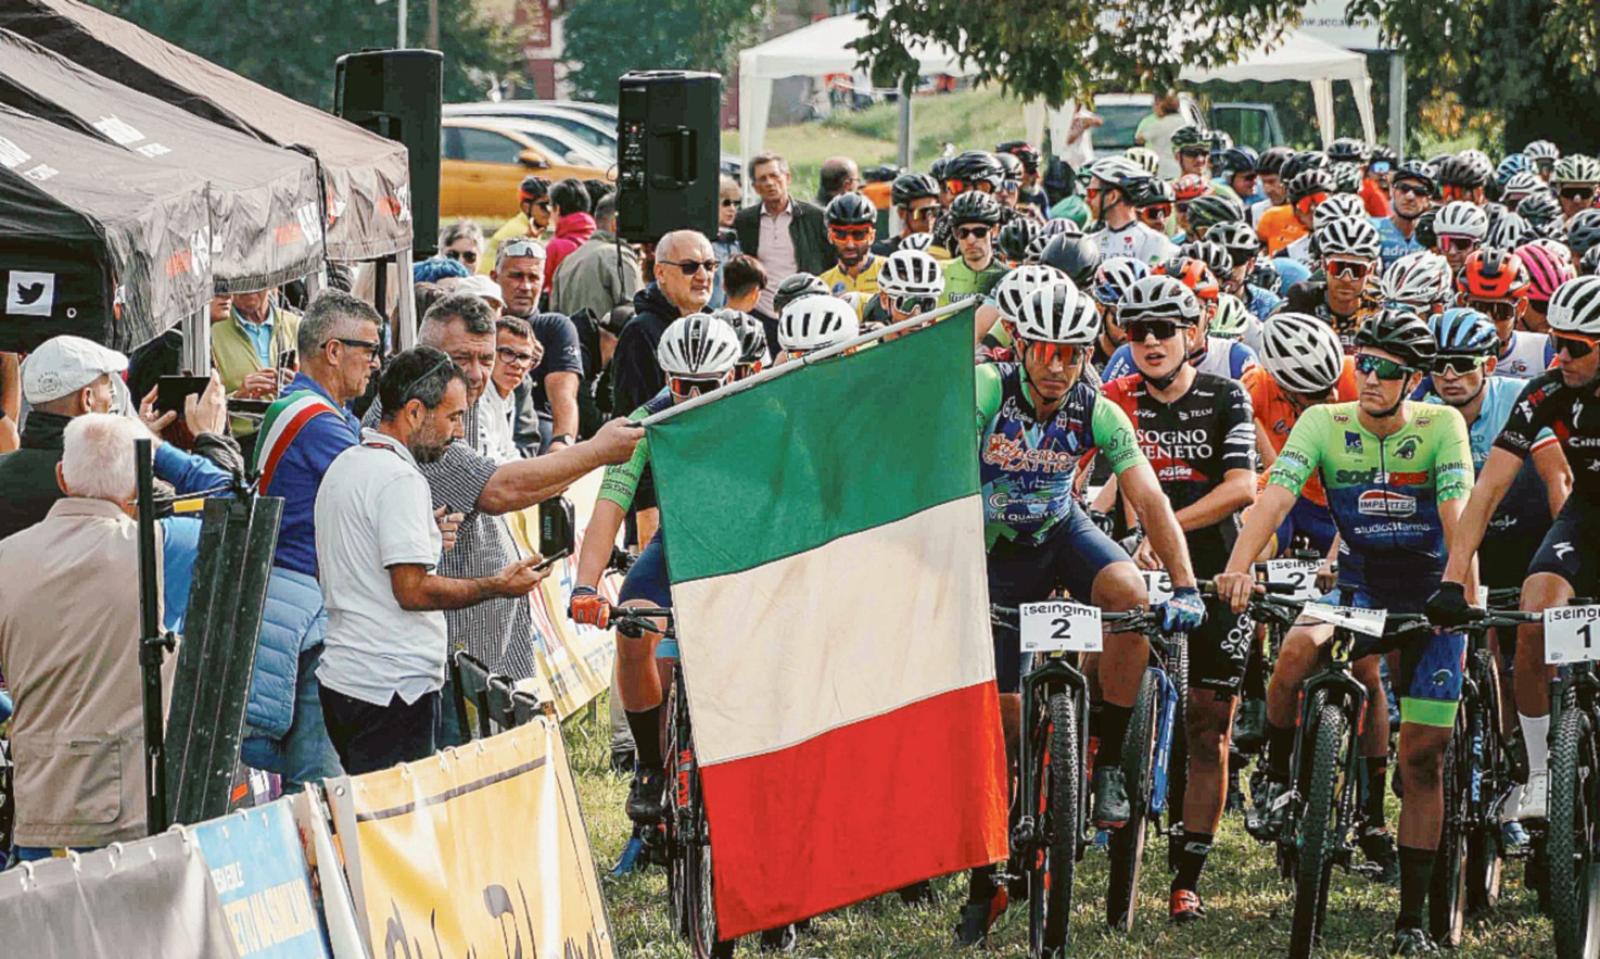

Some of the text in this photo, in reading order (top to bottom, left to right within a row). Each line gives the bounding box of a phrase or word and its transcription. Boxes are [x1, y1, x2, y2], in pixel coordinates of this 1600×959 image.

[1136, 429, 1208, 444] SOGNO
[1050, 618, 1072, 639] 2
[1220, 612, 1252, 651] SOG
[1576, 624, 1592, 648] 1
